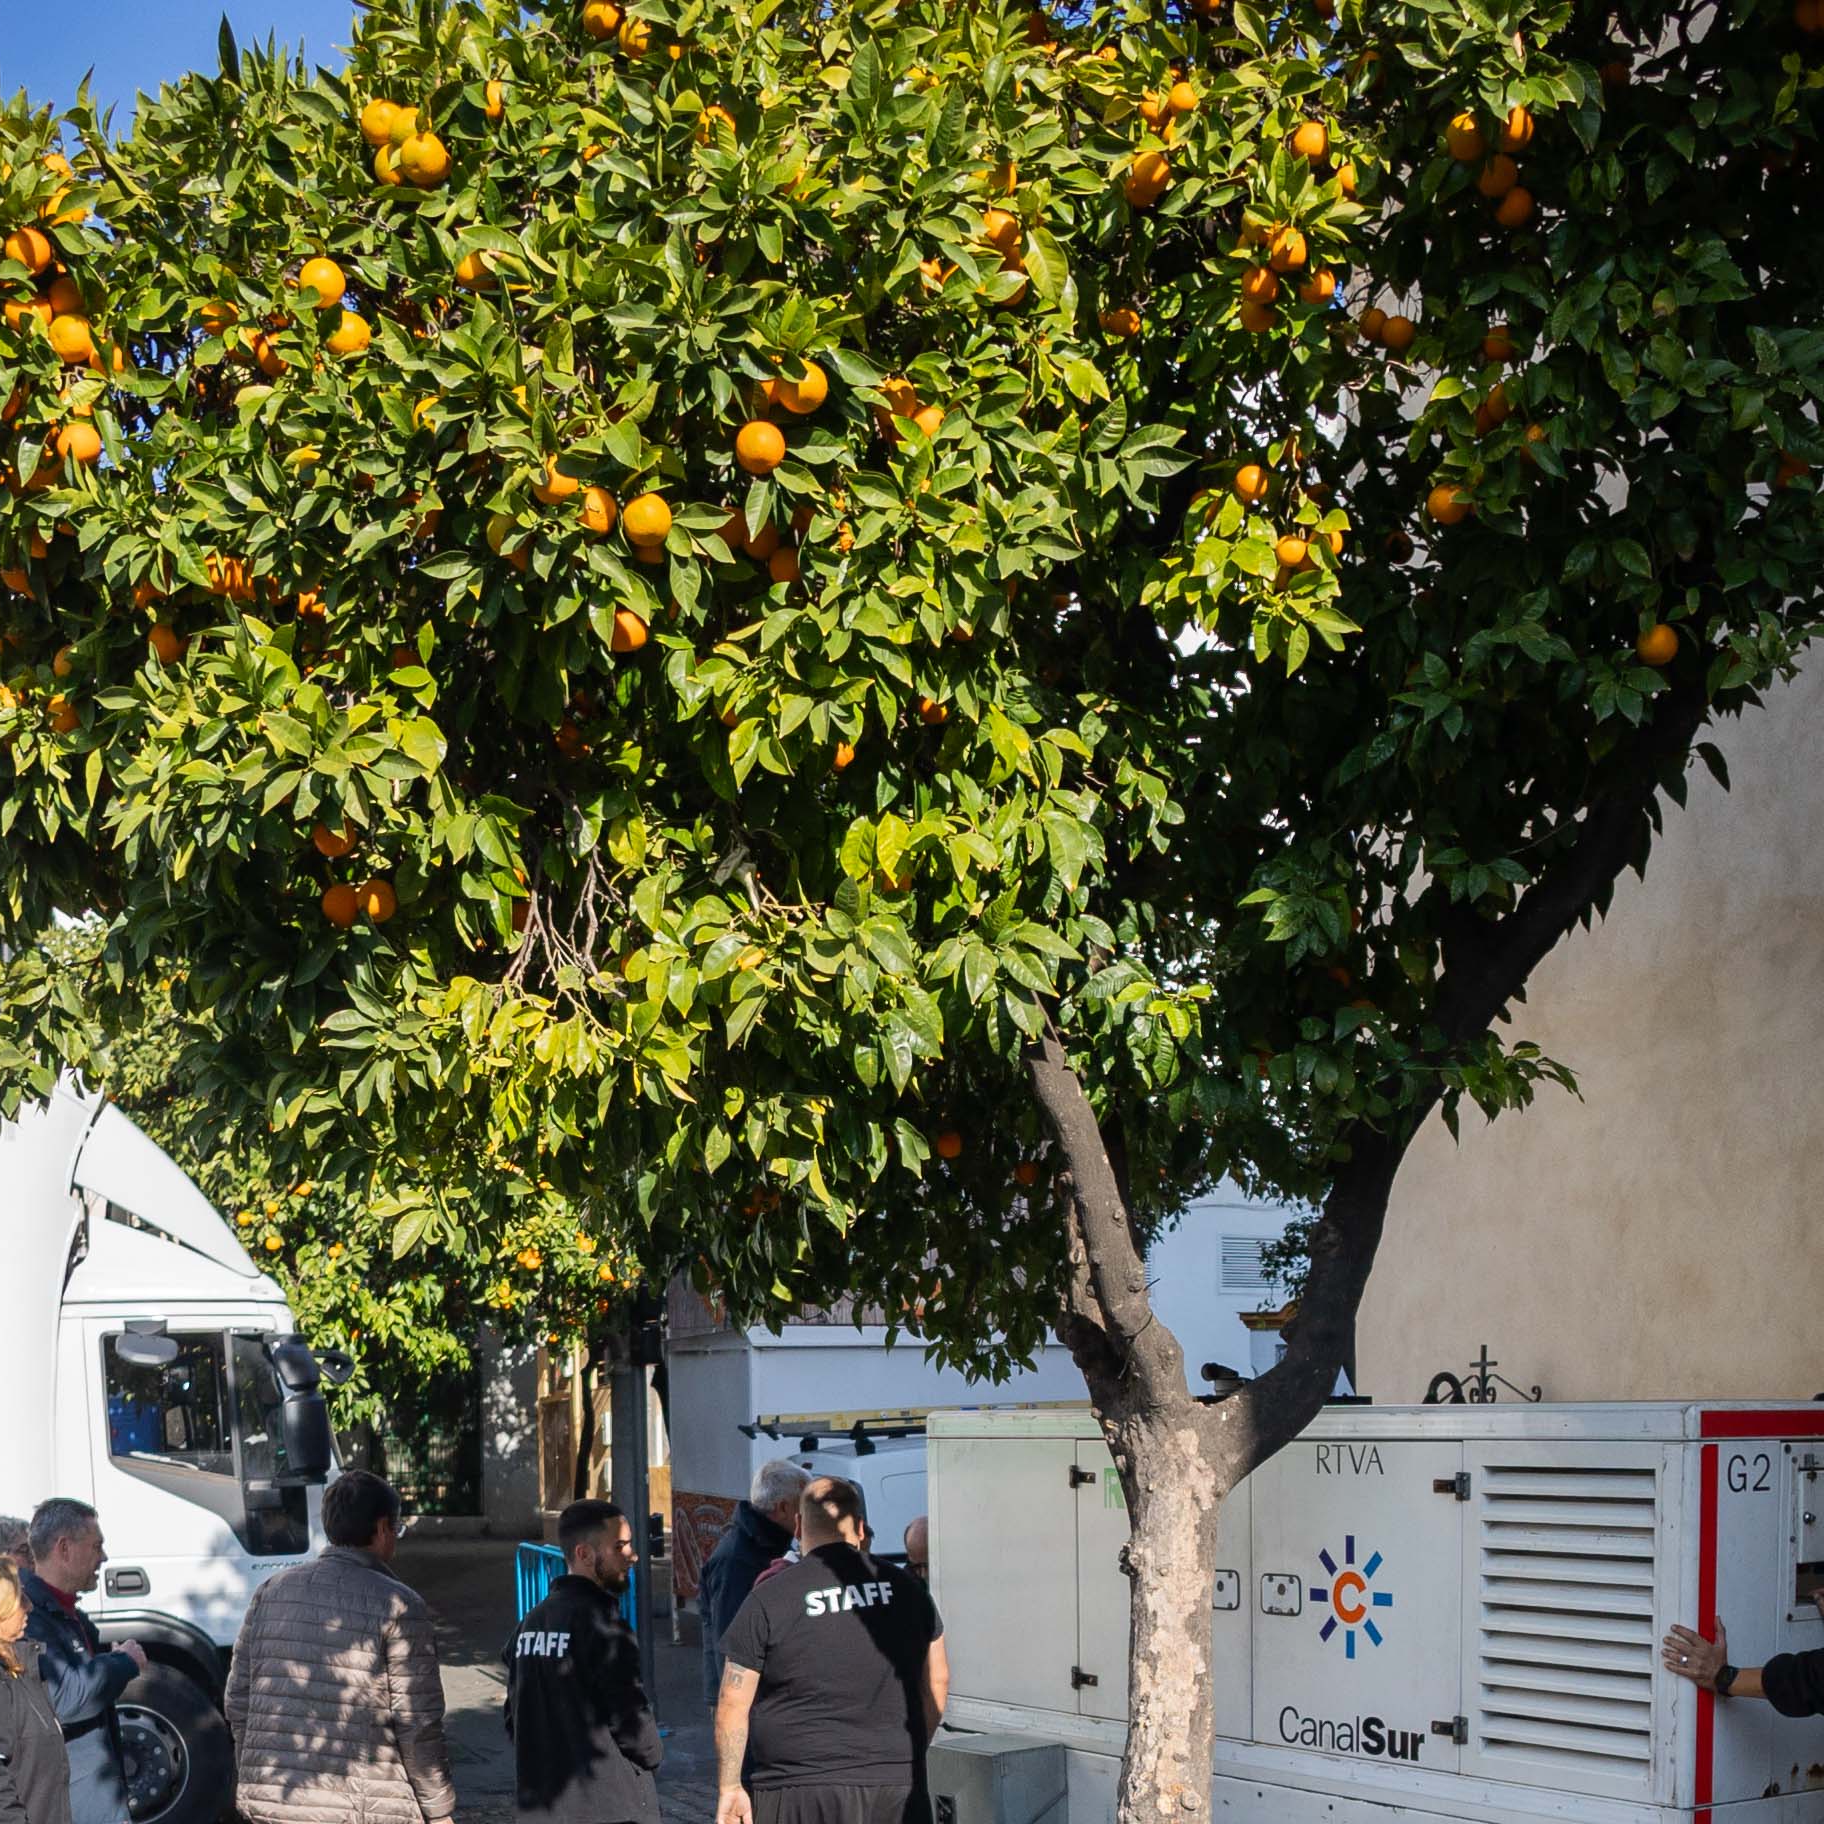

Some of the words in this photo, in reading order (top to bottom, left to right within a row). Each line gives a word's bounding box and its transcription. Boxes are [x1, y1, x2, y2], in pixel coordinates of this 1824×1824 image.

[1316, 1444, 1384, 1475] RTVA
[1727, 1453, 1771, 1493] G2
[805, 1582, 894, 1617] STAFF
[516, 1631, 570, 1658] STAFF
[1279, 1706, 1425, 1762] CanalSur
